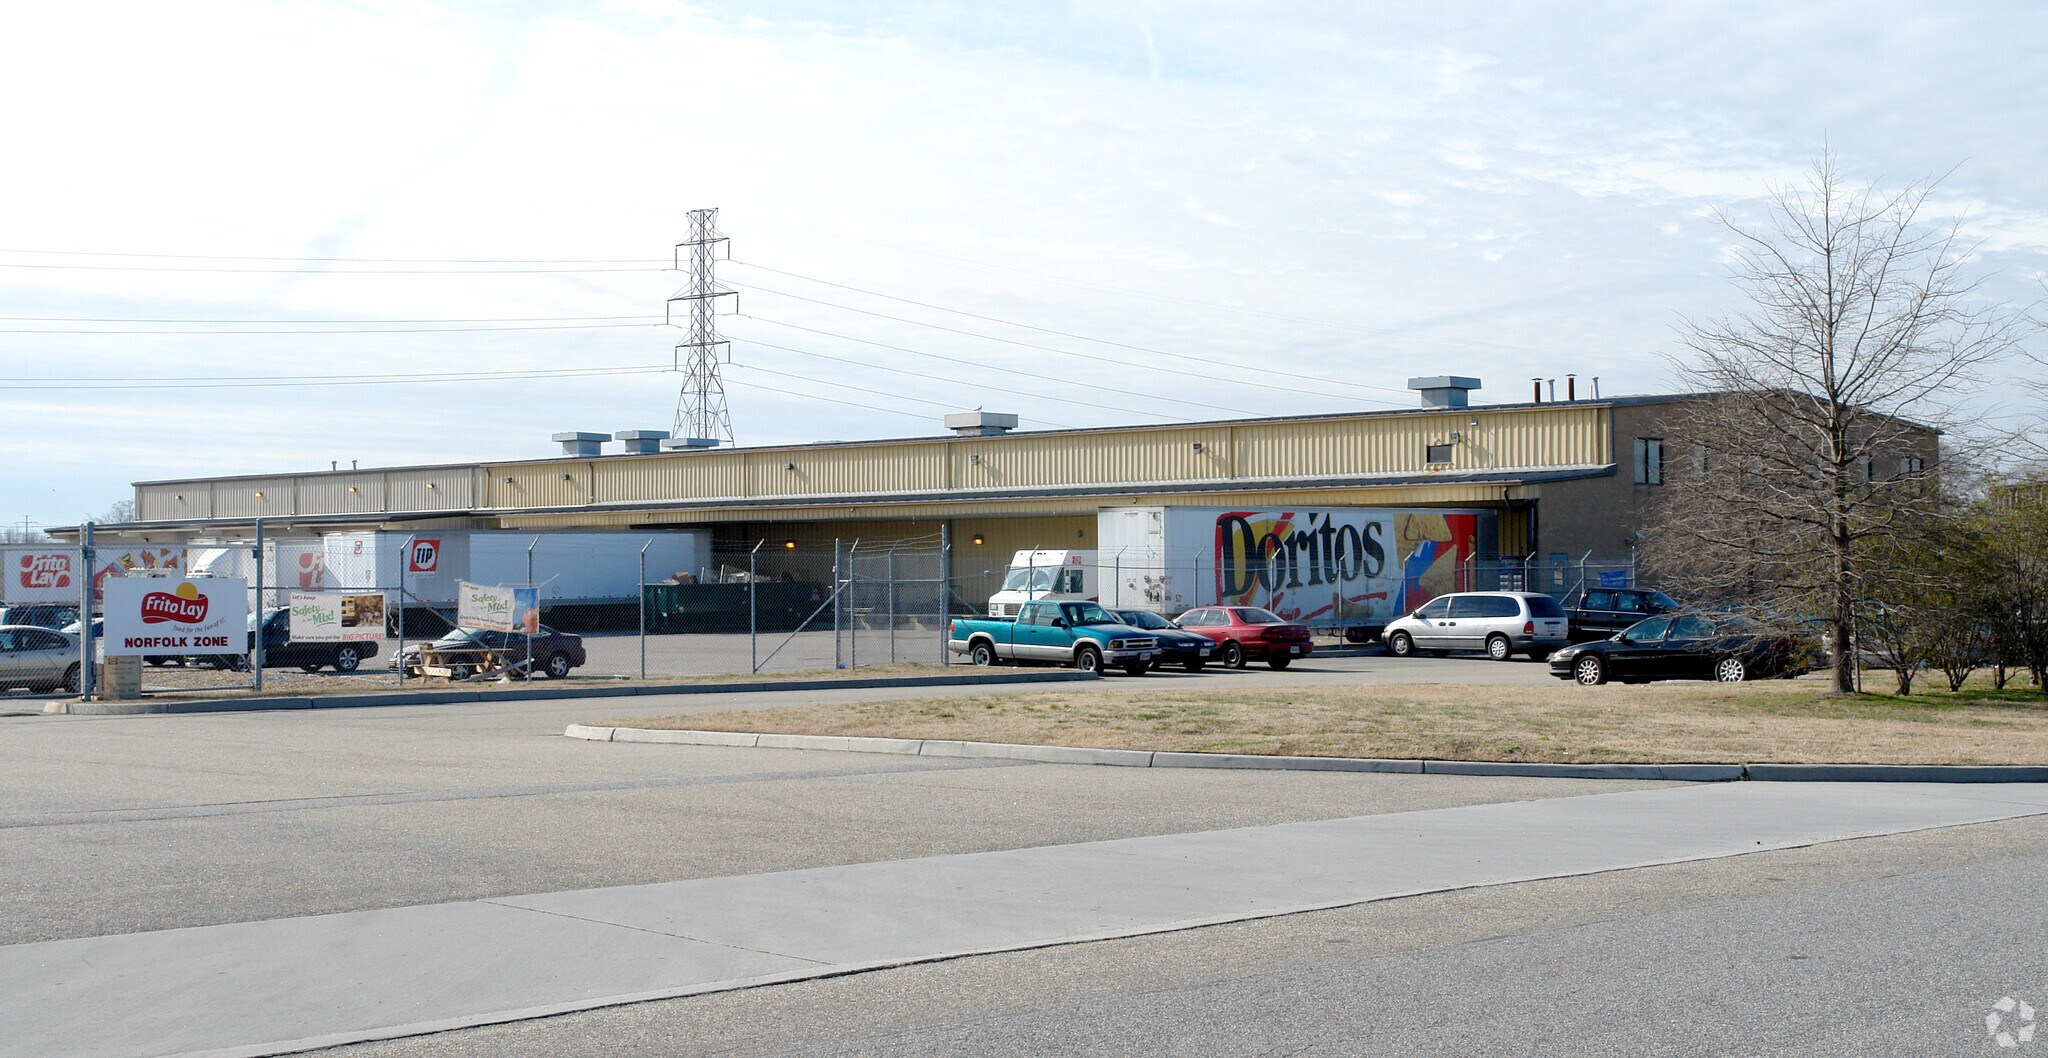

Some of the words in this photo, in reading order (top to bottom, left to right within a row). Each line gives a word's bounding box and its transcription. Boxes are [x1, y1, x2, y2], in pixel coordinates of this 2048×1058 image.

[416, 548, 433, 563] TIP
[1217, 512, 1385, 598] Doritos
[21, 554, 68, 571] Frito
[30, 569, 70, 588] Lay
[471, 593, 498, 604] Safety
[487, 599, 508, 612] Mix!
[145, 596, 179, 613] Frito
[180, 600, 205, 619] Lay
[292, 604, 321, 617] Safety
[312, 609, 334, 625] Mix!
[173, 624, 185, 632] food
[124, 637, 188, 648] NORFOLK
[194, 636, 228, 647] ZONE
[342, 633, 354, 641] BIG
[355, 632, 385, 640] PICTURE!
